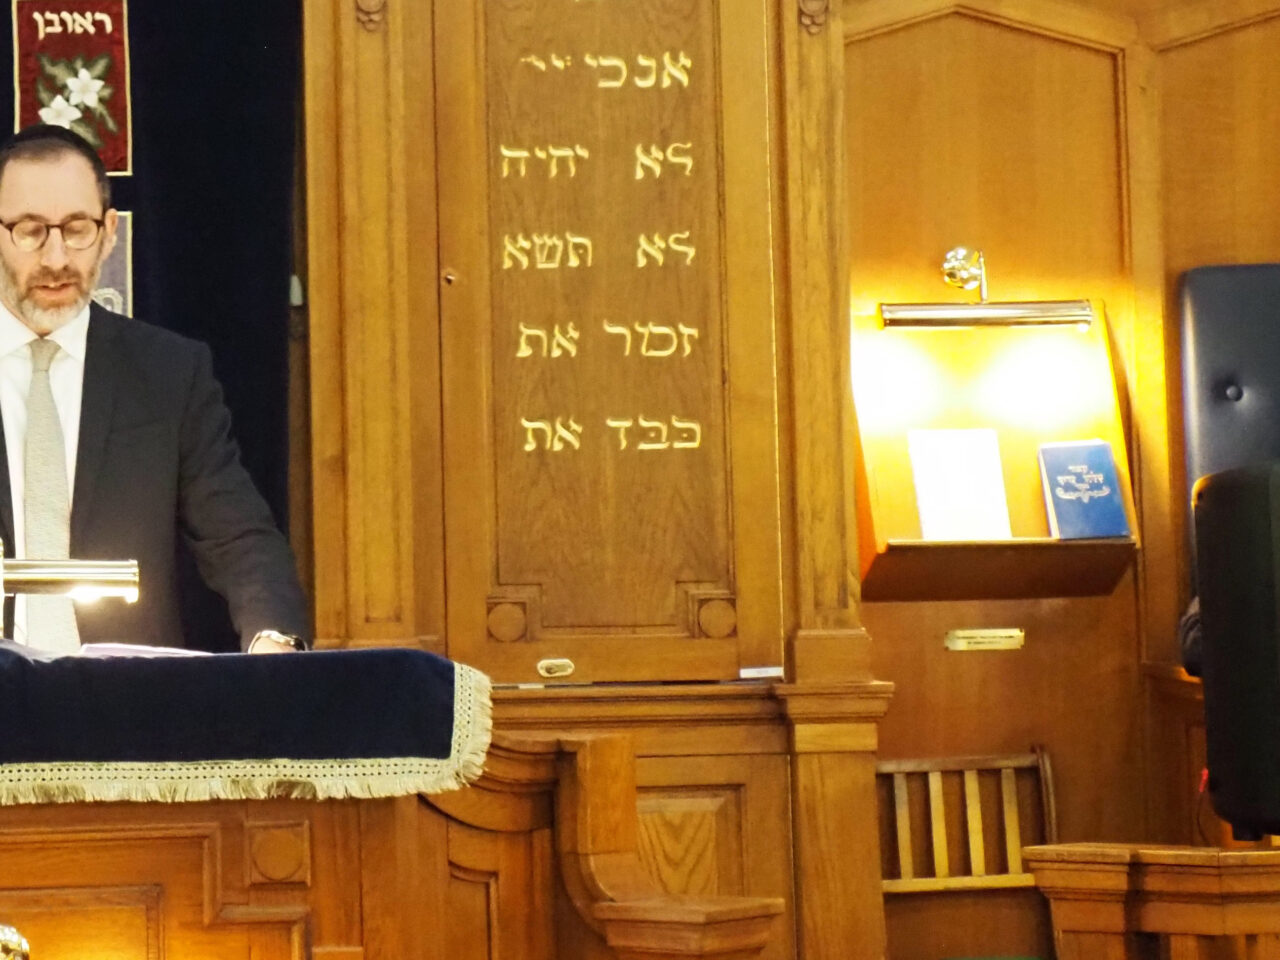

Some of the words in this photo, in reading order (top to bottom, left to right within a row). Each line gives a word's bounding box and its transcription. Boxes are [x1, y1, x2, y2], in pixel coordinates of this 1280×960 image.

[32, 10, 113, 41] ראובן
[583, 50, 692, 89] אנכי
[634, 142, 694, 180] לא
[502, 230, 593, 270] תשא
[636, 230, 696, 268] לא
[515, 321, 580, 358] את
[520, 416, 583, 452] את
